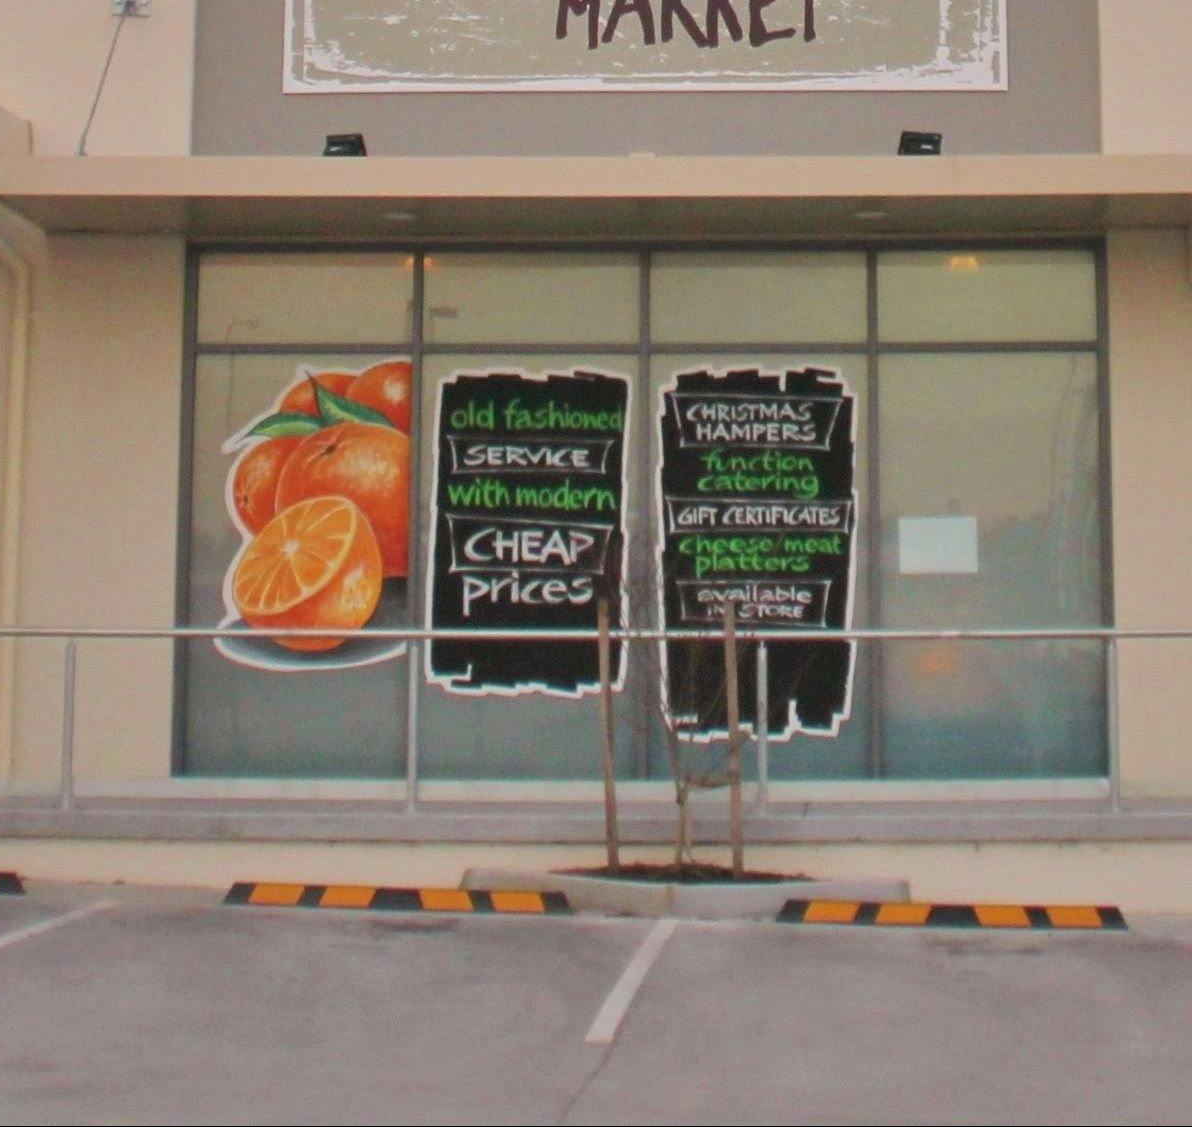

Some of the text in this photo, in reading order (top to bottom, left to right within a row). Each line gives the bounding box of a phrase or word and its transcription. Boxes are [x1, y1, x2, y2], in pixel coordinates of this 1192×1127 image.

[450, 397, 622, 430] old fashioned
[686, 402, 813, 422] CHRISTMAS
[696, 423, 816, 442] HAMPERS
[463, 444, 590, 467] SERVICE
[701, 449, 814, 472] function
[448, 478, 616, 510] with modern
[697, 470, 820, 499] catering
[677, 505, 841, 526] GIFT CERTIFICATES
[464, 527, 594, 565] CHEAP
[784, 534, 842, 554] meat
[696, 551, 810, 579] platters
[463, 572, 594, 617] prices
[697, 584, 812, 603] available
[738, 604, 805, 618] STORE
